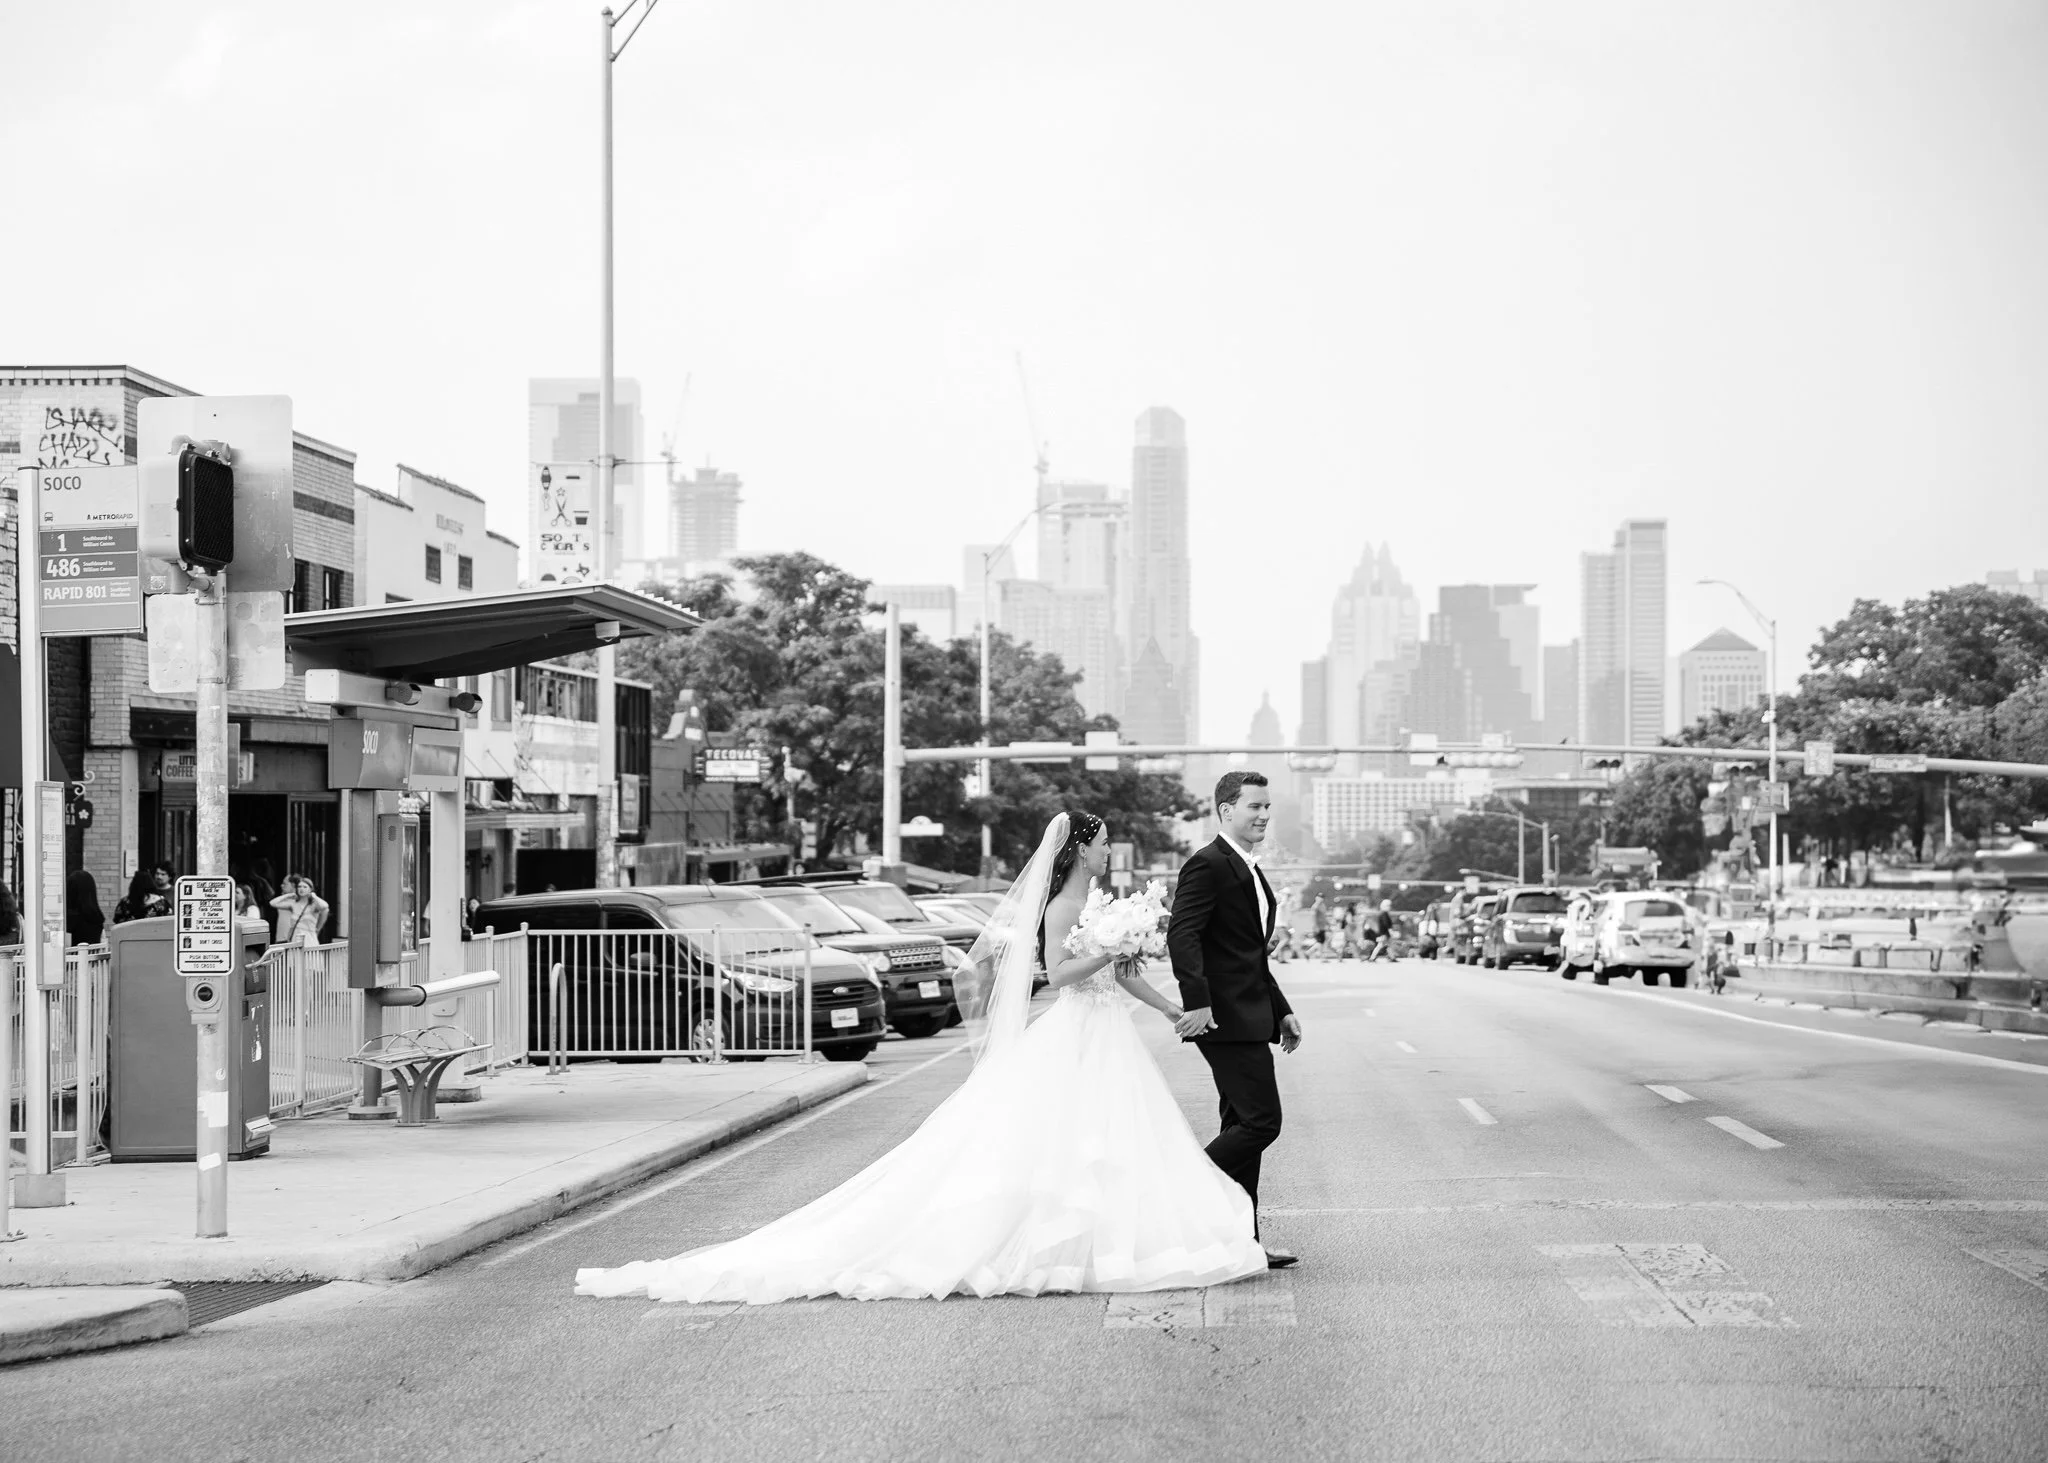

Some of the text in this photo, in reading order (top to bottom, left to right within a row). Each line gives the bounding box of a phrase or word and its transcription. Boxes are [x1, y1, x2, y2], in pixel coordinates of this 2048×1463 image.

[44, 476, 82, 491] SOCO
[57, 533, 67, 552] 1
[46, 558, 81, 577] 486
[44, 586, 83, 601] RAPID
[85, 585, 107, 599] 801
[362, 730, 379, 755] SOCO
[705, 748, 761, 760] TECOVAS
[166, 765, 193, 777] COFFEE
